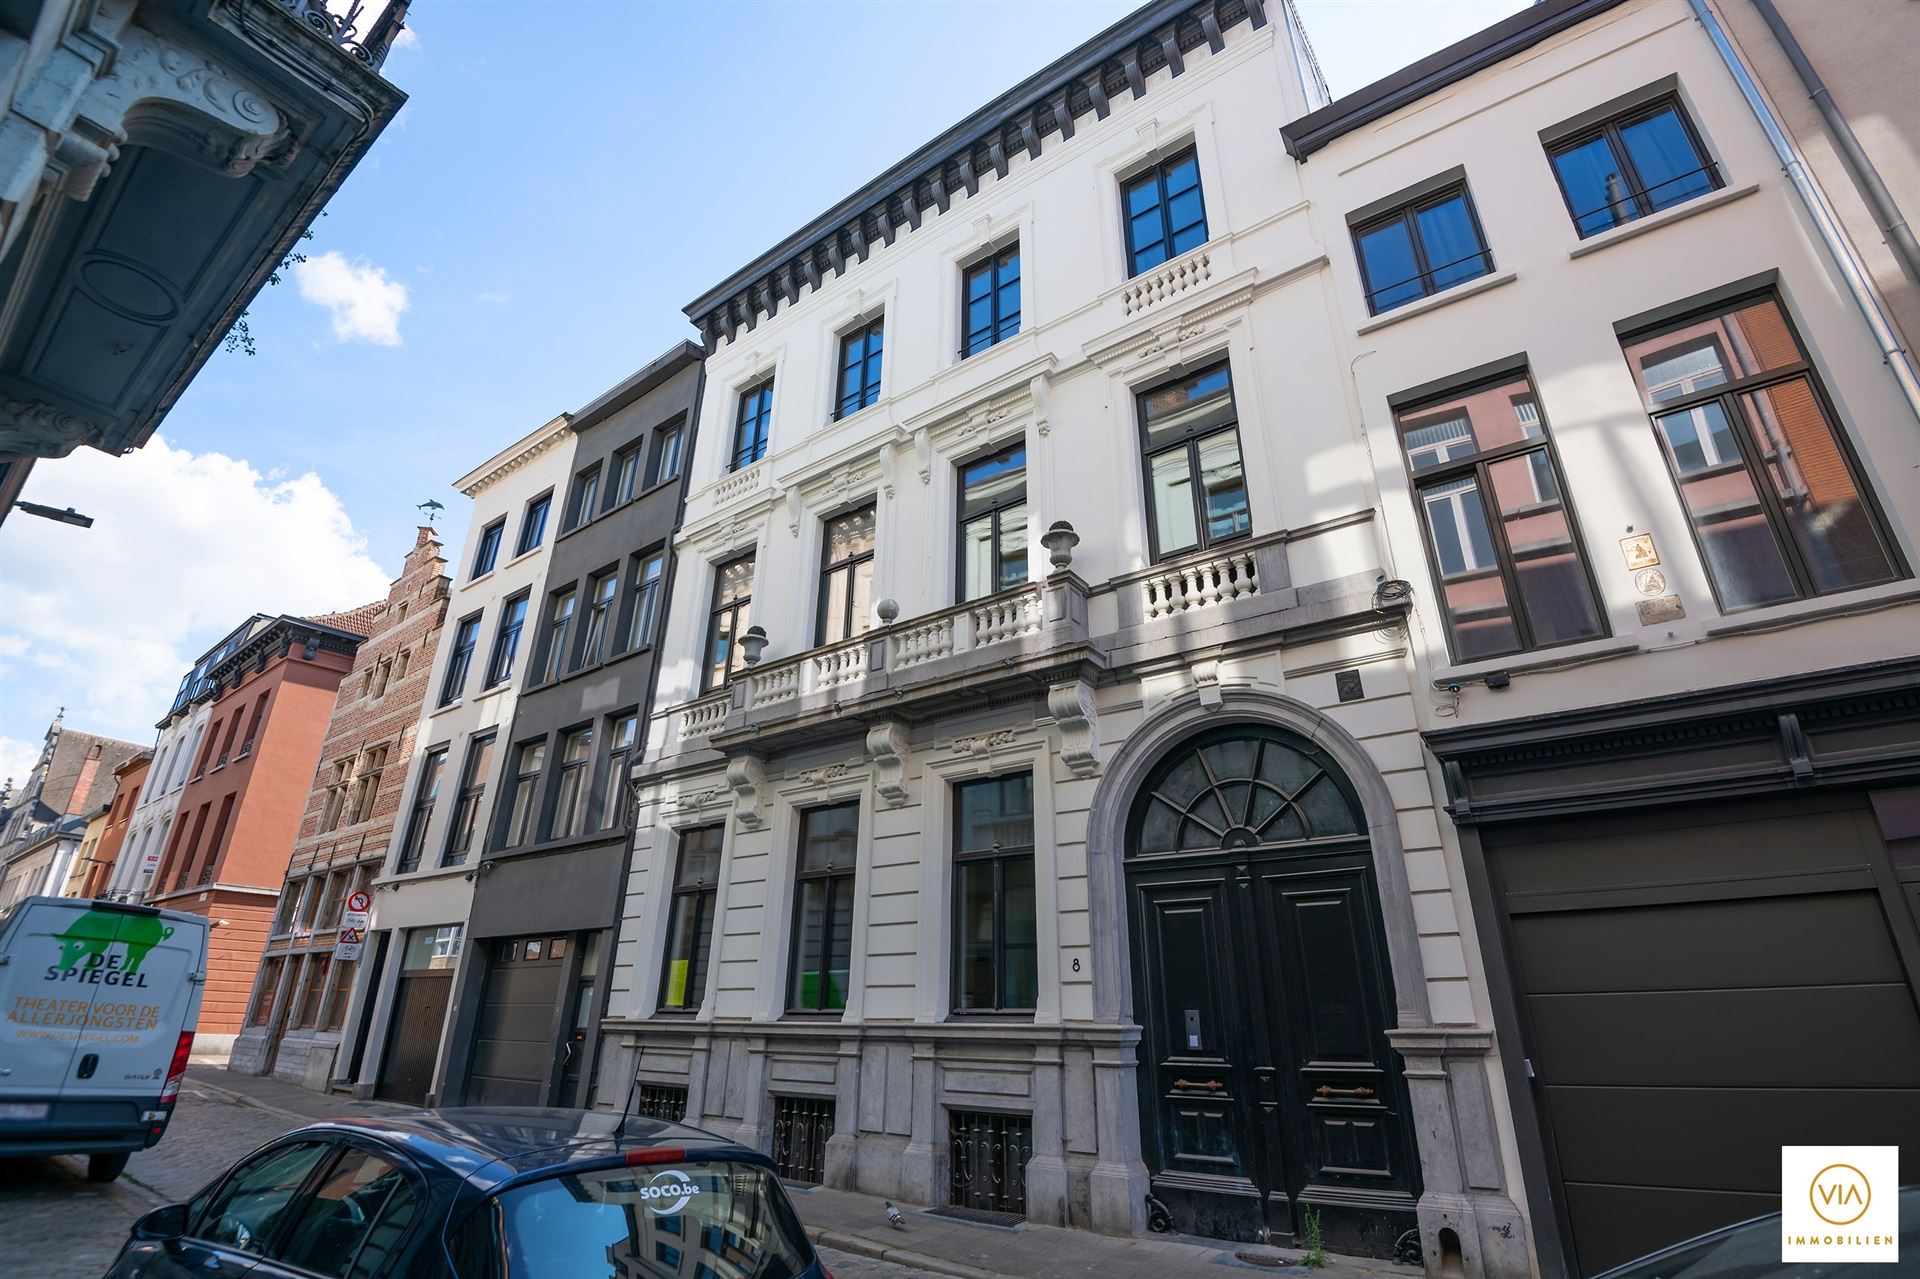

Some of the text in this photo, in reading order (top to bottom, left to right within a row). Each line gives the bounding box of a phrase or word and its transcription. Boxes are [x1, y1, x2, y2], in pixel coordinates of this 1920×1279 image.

[87, 953, 122, 970] DE
[1072, 958, 1080, 972] 8
[44, 965, 148, 988] SPIEGEL
[15, 996, 161, 1018] THEATER VOOR DE
[6, 1010, 158, 1030] ALLERJONGSTEN
